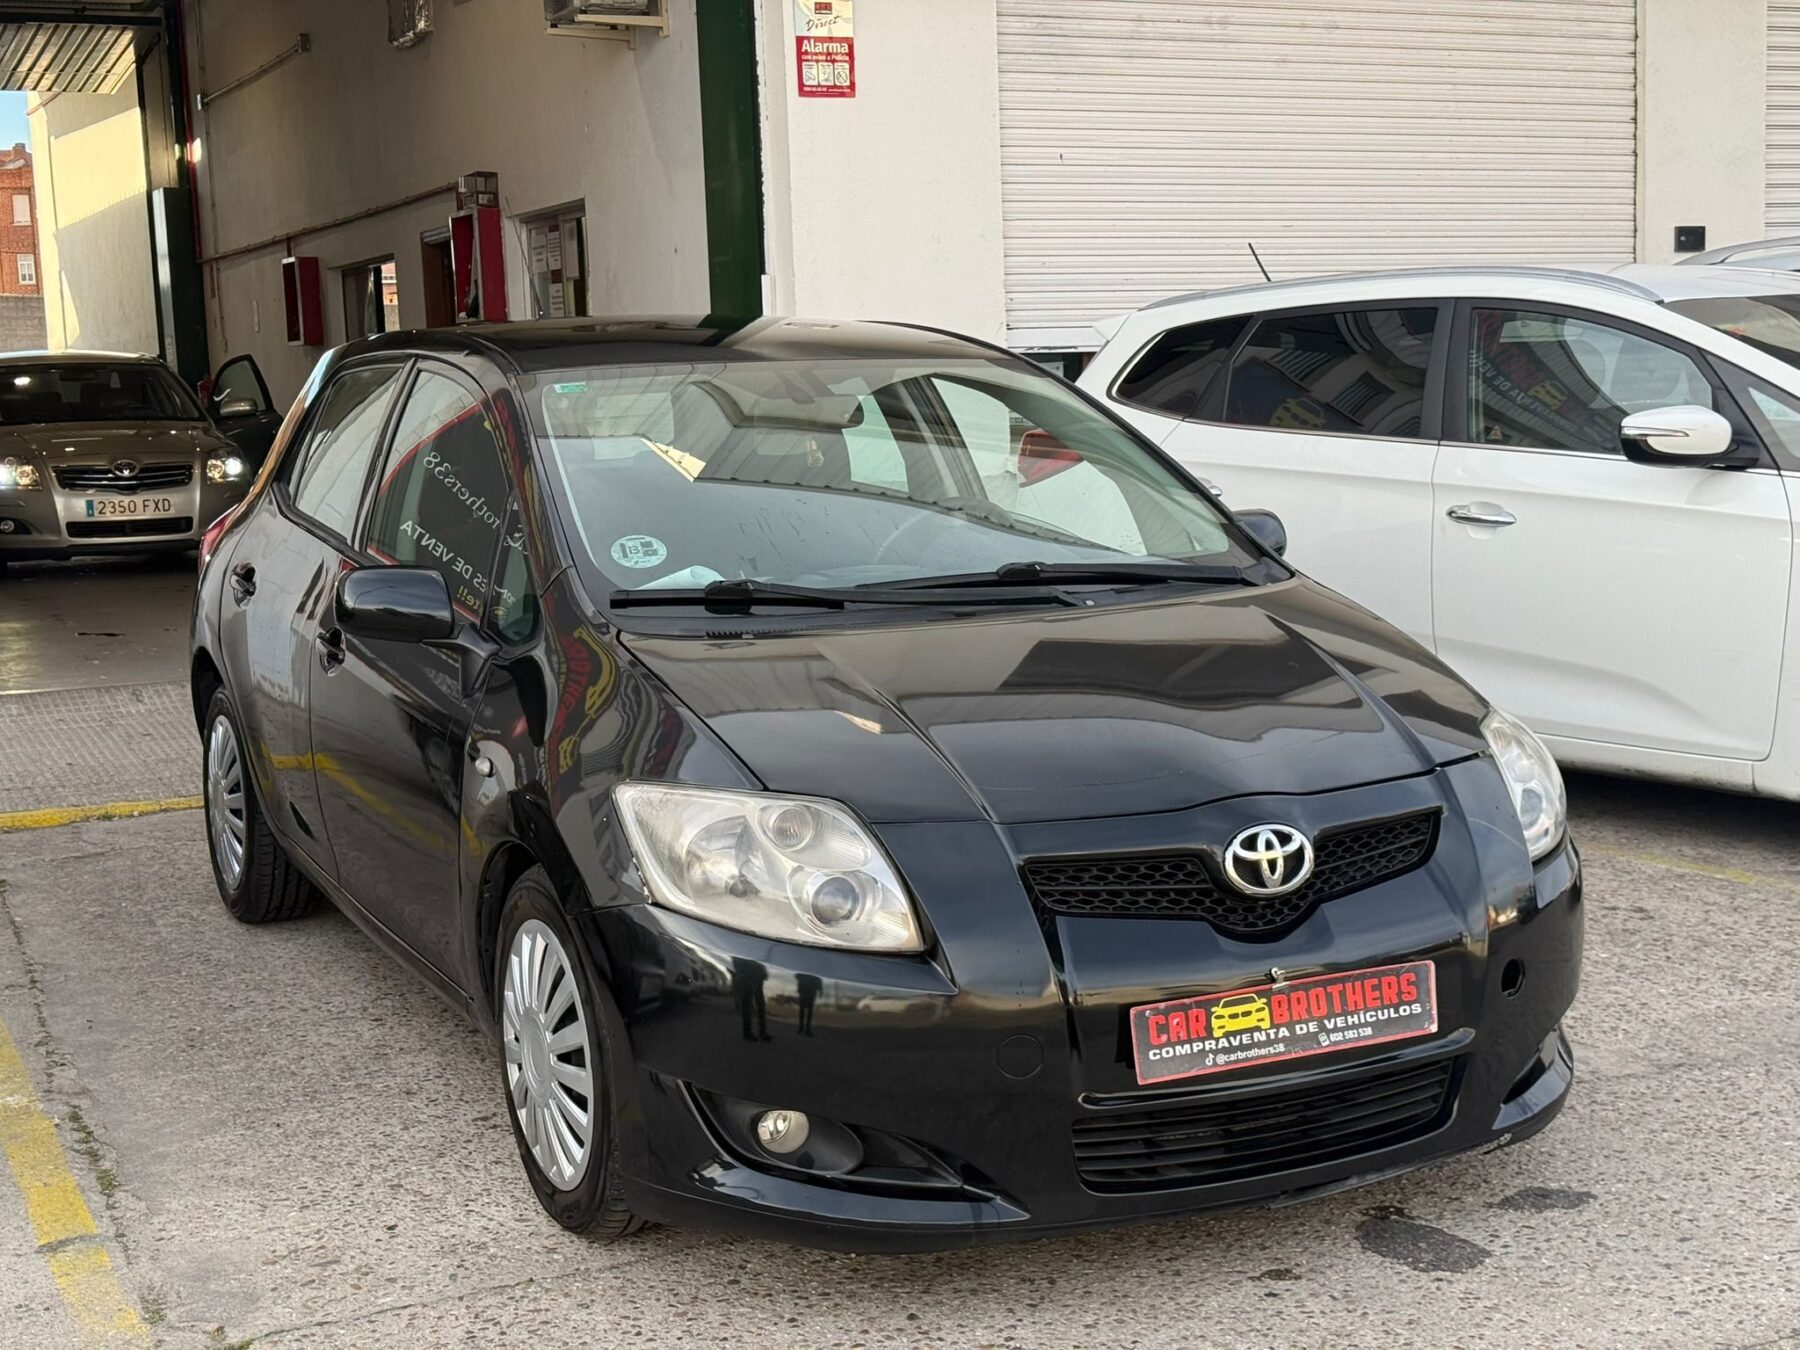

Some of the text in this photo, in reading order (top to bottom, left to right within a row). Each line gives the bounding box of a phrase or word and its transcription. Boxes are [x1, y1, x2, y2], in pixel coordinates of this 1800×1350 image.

[801, 39, 849, 53] Alarma
[98, 498, 171, 515] 2350 FXD
[1149, 972, 1418, 1046] CAR BROTHERS
[1148, 1002, 1422, 1061] COMPRAVENTA DE VEHÍCULOS
[1215, 1042, 1286, 1066] @carbrothers38
